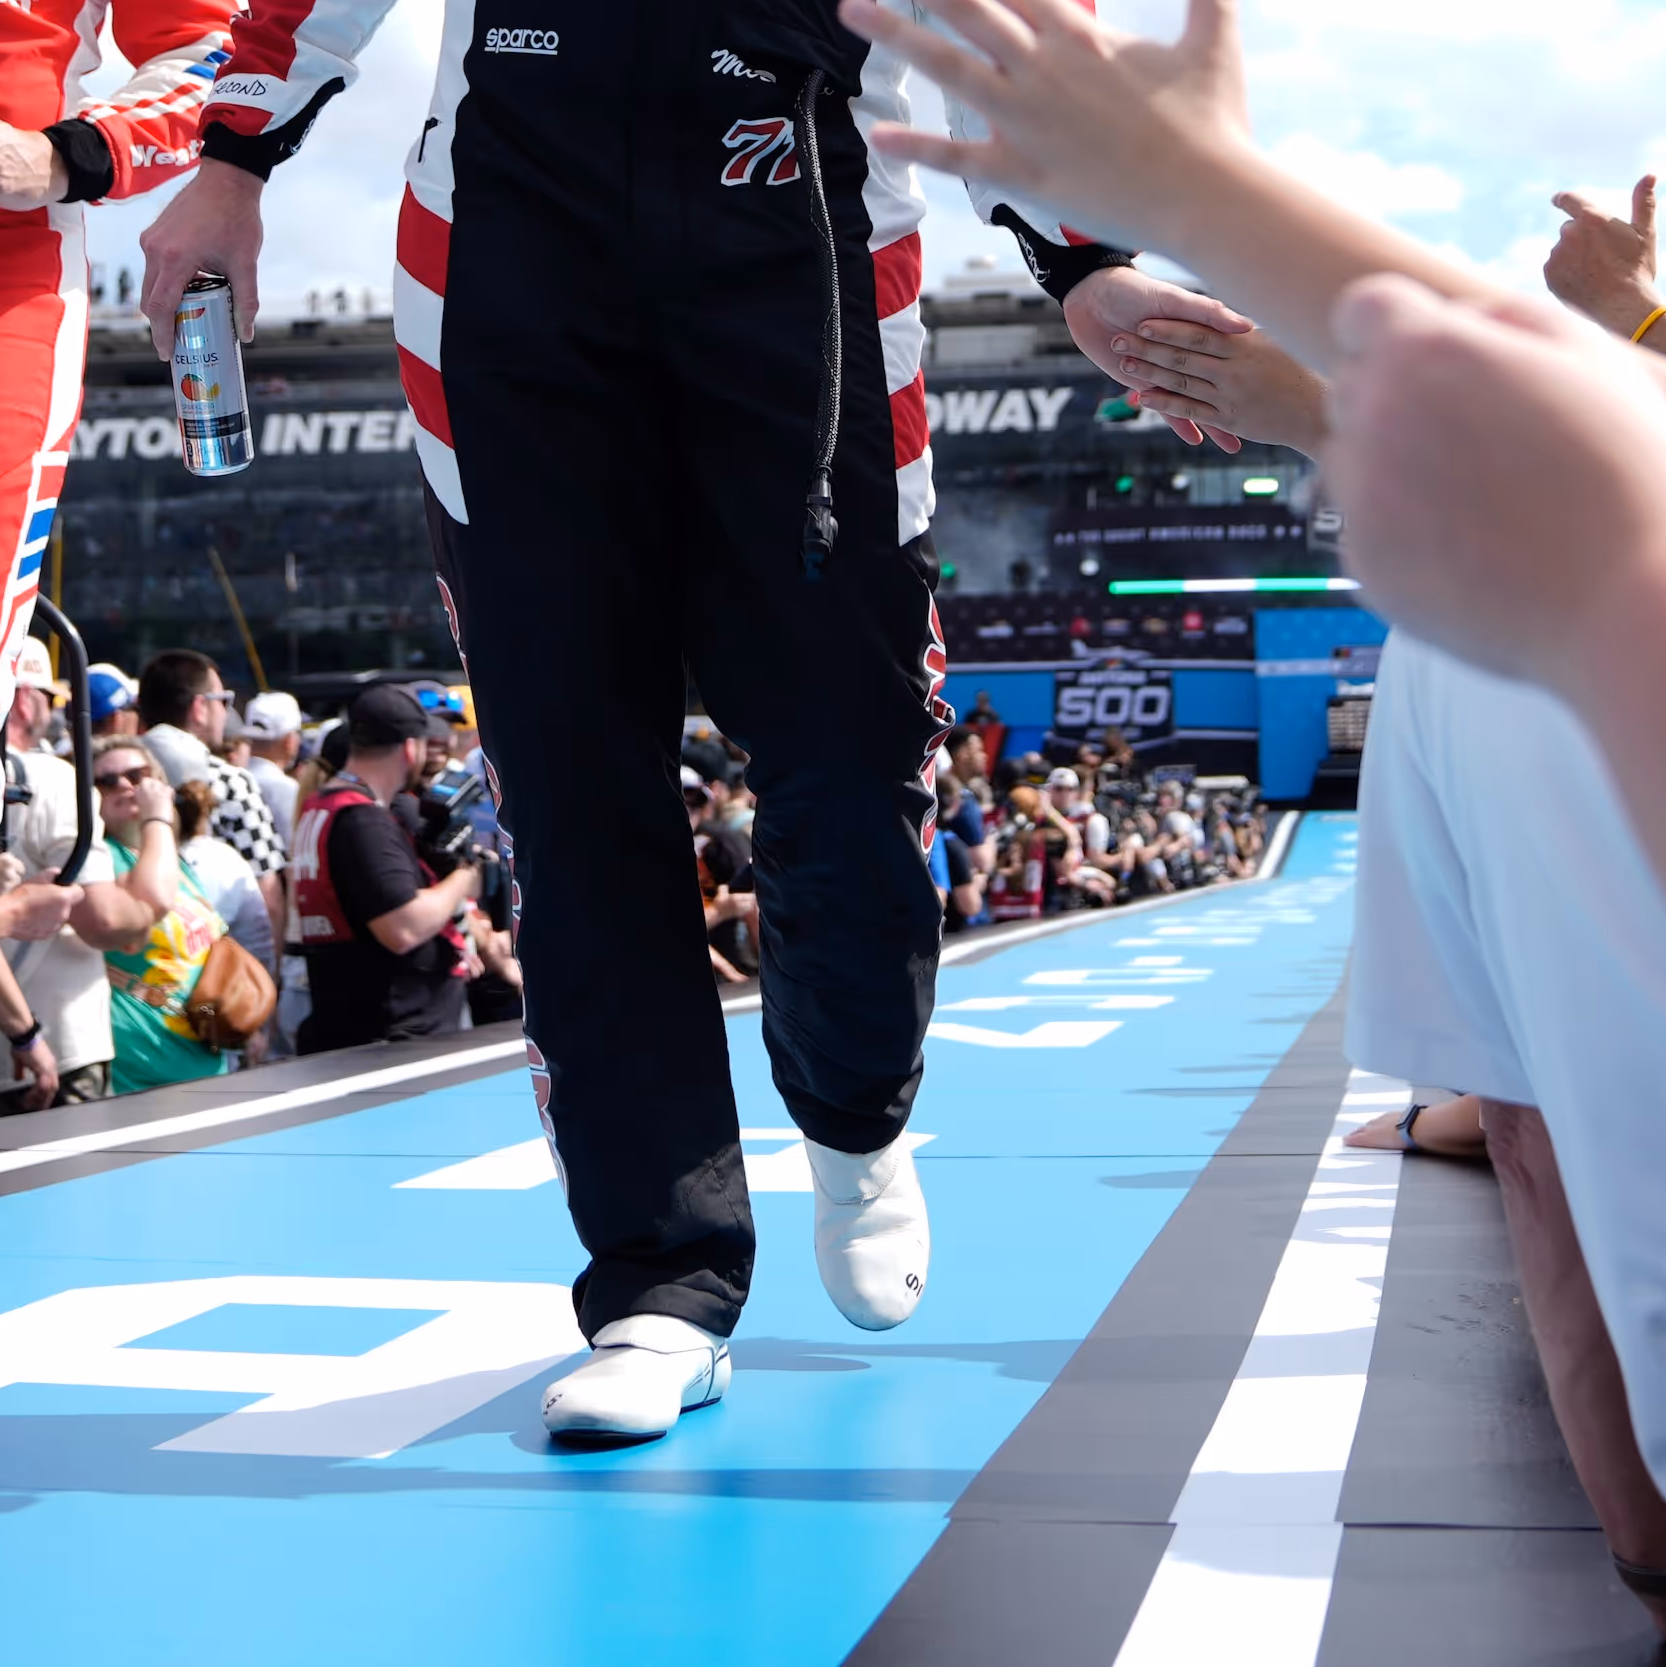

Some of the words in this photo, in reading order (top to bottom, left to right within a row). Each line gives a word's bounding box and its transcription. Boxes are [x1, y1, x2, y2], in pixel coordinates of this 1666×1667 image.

[484, 27, 559, 55] sparco
[175, 352, 219, 365] CELSIUS
[1055, 685, 1171, 727] 500
